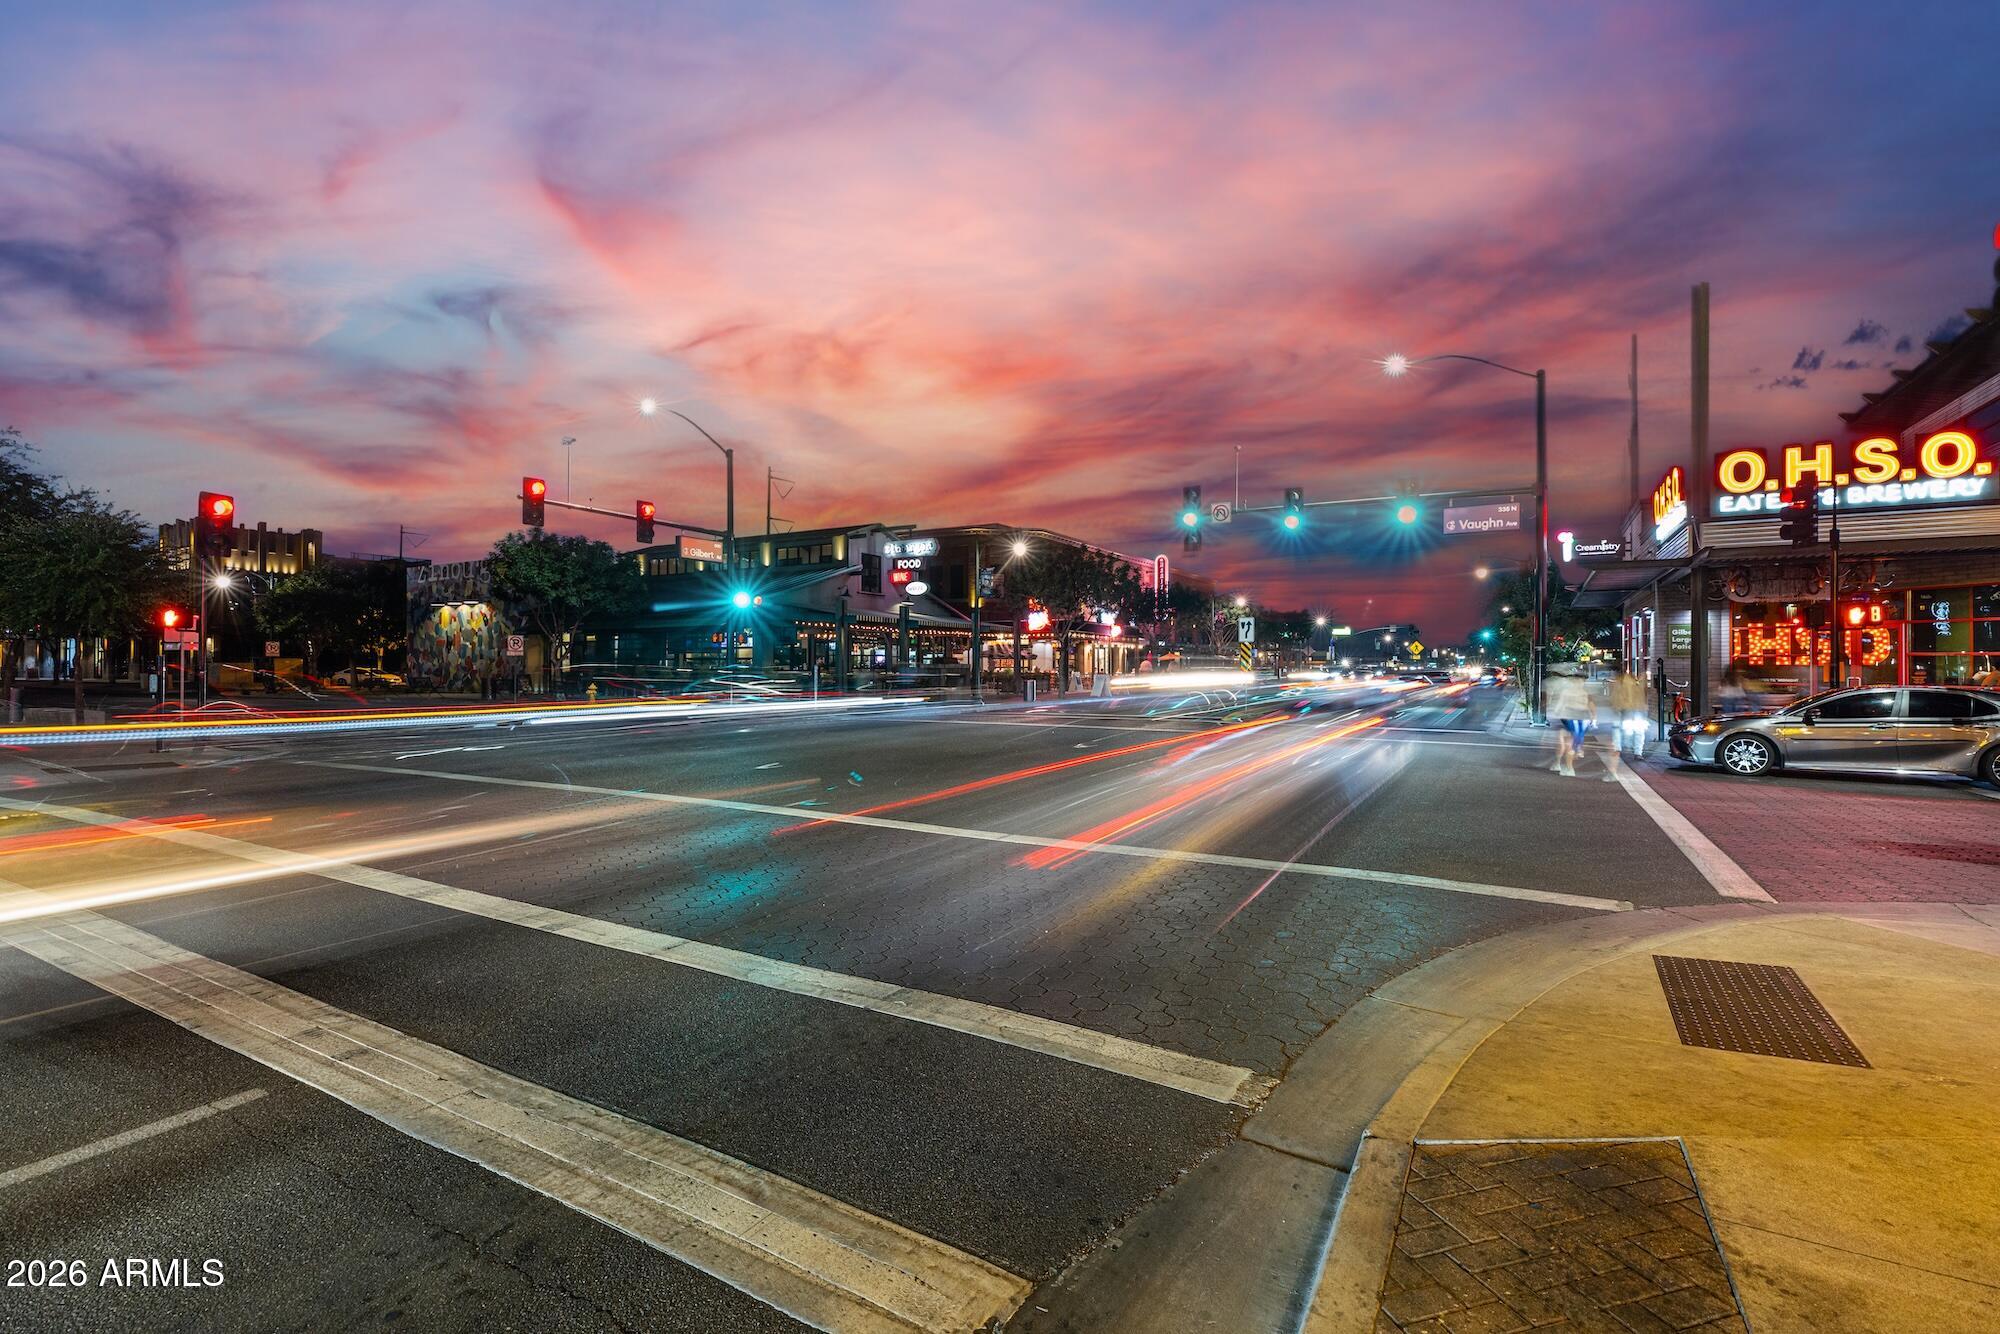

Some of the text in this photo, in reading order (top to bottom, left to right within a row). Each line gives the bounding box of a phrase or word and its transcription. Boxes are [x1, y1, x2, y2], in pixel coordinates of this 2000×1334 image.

[1719, 431, 1992, 494] O.H.S.O.
[1821, 487, 1840, 506] &
[1847, 477, 1987, 504] BREWERY
[1459, 517, 1504, 531] Vaughn
[1575, 539, 1621, 551] Creamistry
[690, 548, 715, 559] Gilbert
[897, 558, 921, 569] FOOD
